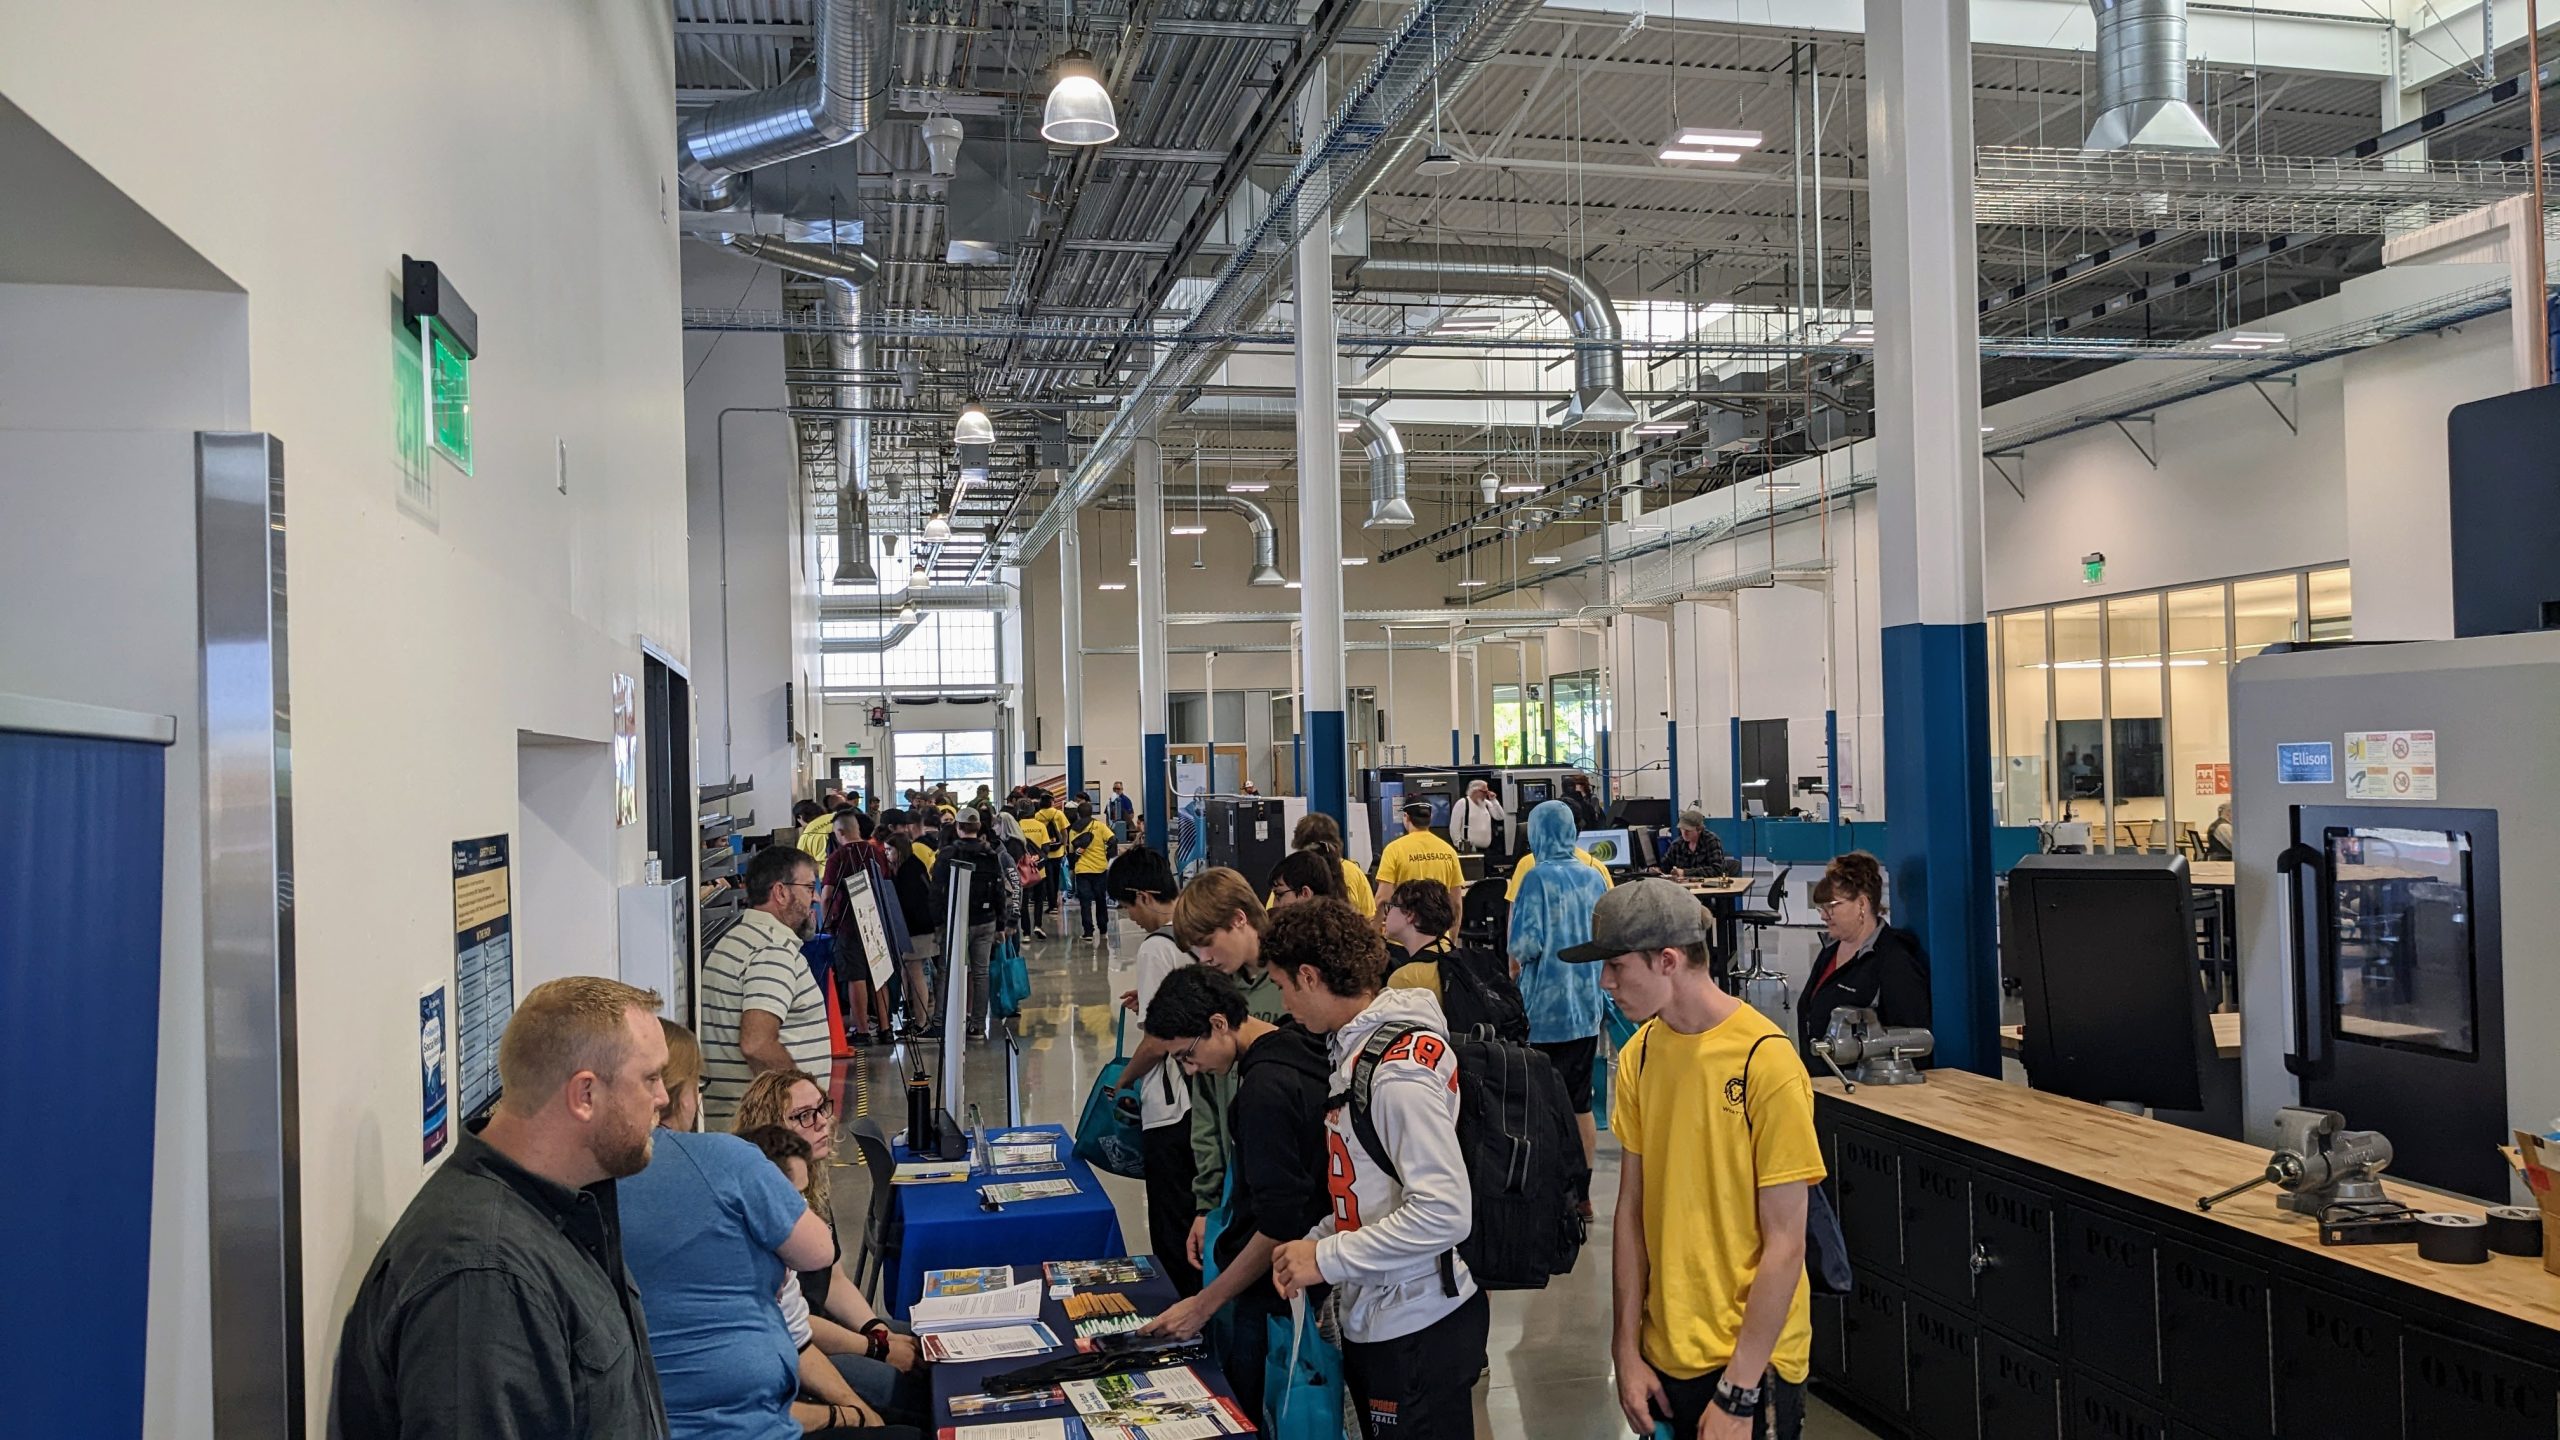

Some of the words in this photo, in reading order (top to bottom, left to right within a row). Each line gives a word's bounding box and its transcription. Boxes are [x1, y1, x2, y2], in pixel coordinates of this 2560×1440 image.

[2292, 752, 2327, 765] Ellison
[1409, 853, 1453, 862] AMBASSADOR
[1381, 1031, 1446, 1072] 28
[1846, 1141, 1894, 1176] OMIC
[1919, 1166, 1958, 1200] PCC
[1984, 1192, 2043, 1234] OMIC
[2086, 1227, 2138, 1268] PCC
[1859, 1282, 1894, 1318] PCC
[2175, 1261, 2257, 1312] OMIC
[1918, 1312, 1970, 1356] OMIC
[2305, 1306, 2375, 1357] PCC
[1998, 1353, 2042, 1396] PCC
[2421, 1354, 2539, 1420] OMIC
